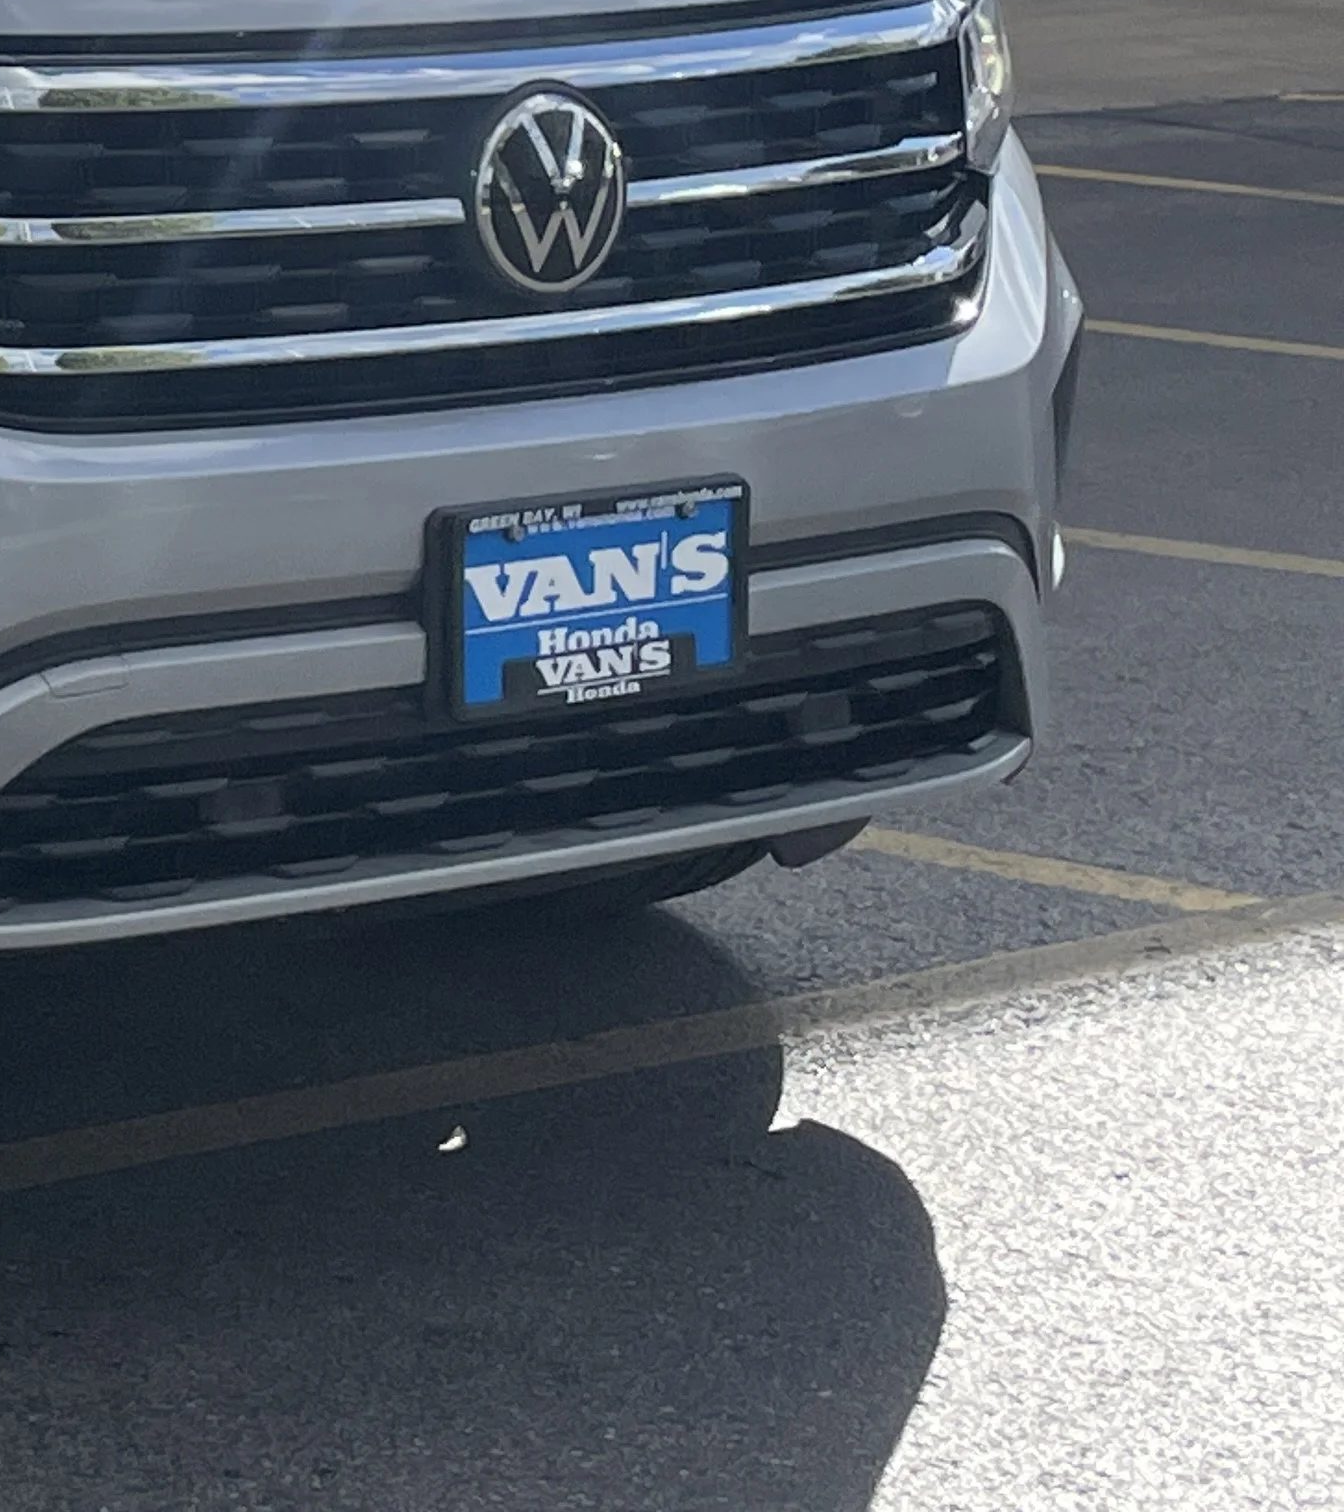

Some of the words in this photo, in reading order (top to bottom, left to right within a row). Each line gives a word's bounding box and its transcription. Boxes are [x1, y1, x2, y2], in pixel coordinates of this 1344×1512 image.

[469, 514, 520, 533] GREEN
[465, 531, 729, 621] VAN'S
[538, 616, 659, 655] Honda
[566, 679, 641, 703] Honda
